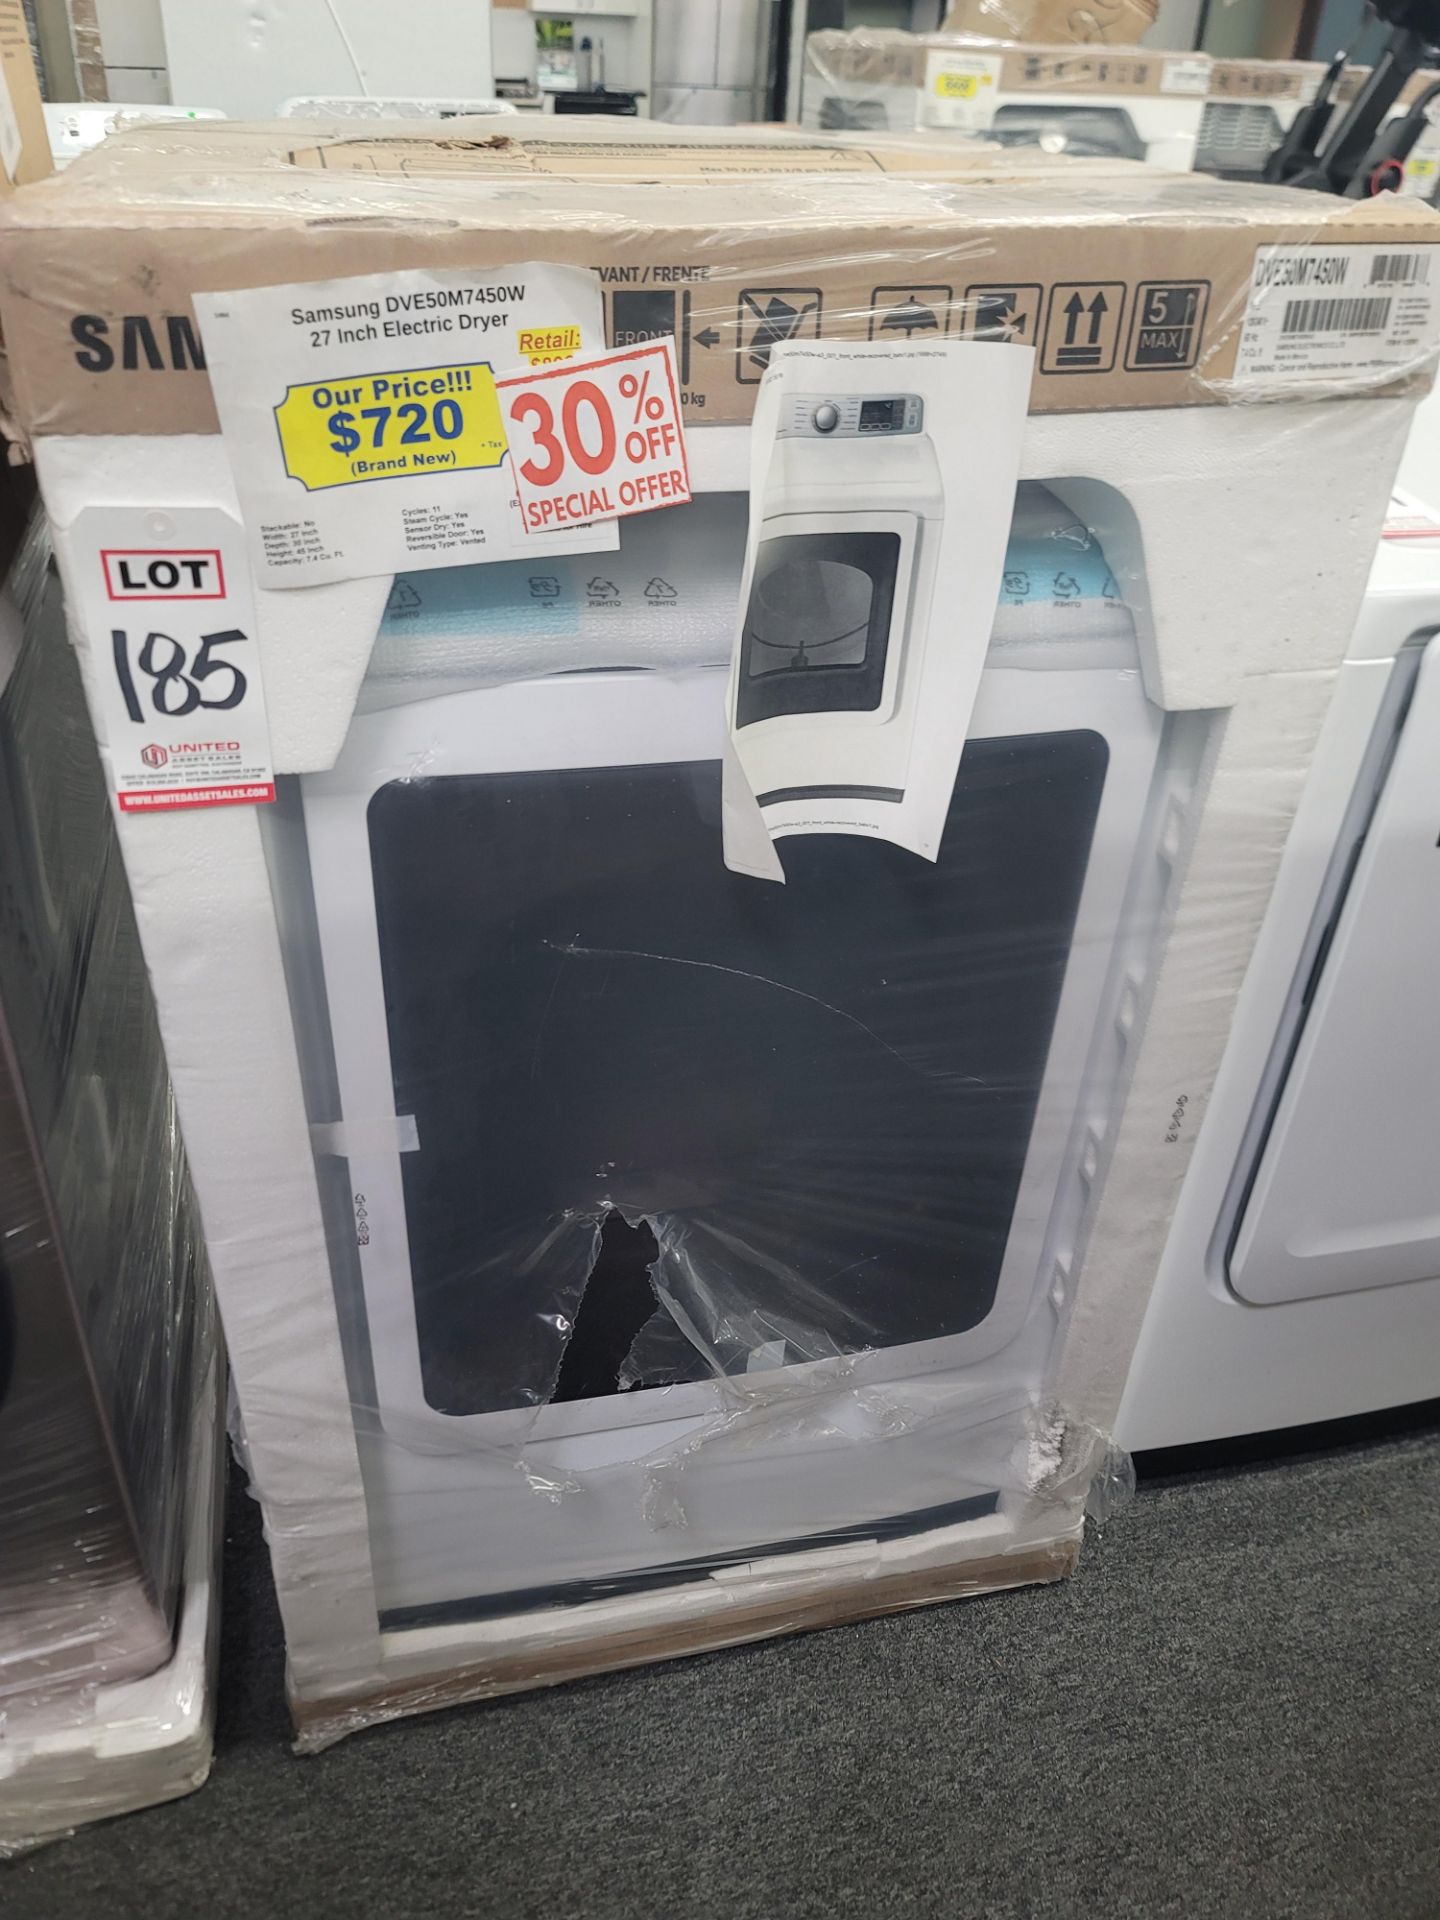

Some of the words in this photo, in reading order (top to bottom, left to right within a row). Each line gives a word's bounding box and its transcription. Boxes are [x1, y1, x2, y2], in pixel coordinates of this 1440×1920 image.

[291, 302, 381, 326] Samsung
[385, 285, 526, 313] DVE50M7450W
[1149, 291, 1169, 324] 5
[311, 330, 332, 348] 27
[338, 324, 378, 345] Inch
[383, 316, 453, 338] Electric
[458, 313, 509, 333] Dryer
[519, 330, 581, 351] Retail:
[1140, 332, 1179, 349] MAX
[312, 387, 363, 409] Our
[372, 370, 473, 401] Price!!!
[327, 399, 464, 457] $720
[510, 380, 616, 487] 30
[618, 370, 665, 425] %
[488, 440, 503, 449] Tax
[625, 423, 676, 464] OFF
[351, 456, 407, 477] (Brand
[413, 450, 457, 467] New)
[402, 508, 430, 517] Cycles:
[528, 487, 616, 527] SPECIAL
[619, 470, 687, 506] OFFER
[403, 517, 428, 525] Steam
[429, 515, 453, 523] Cycle:
[404, 526, 432, 534] Sensor
[433, 523, 449, 531] Dry:
[451, 521, 465, 529] Yes
[406, 533, 446, 542] Reversible
[447, 530, 469, 538] Door:
[470, 528, 484, 536] Yes
[407, 543, 436, 551] Venting
[437, 540, 458, 549] Type:
[460, 537, 486, 546] Vented
[117, 560, 210, 590] LOT
[111, 629, 248, 724] 185
[168, 741, 241, 754] UNITED
